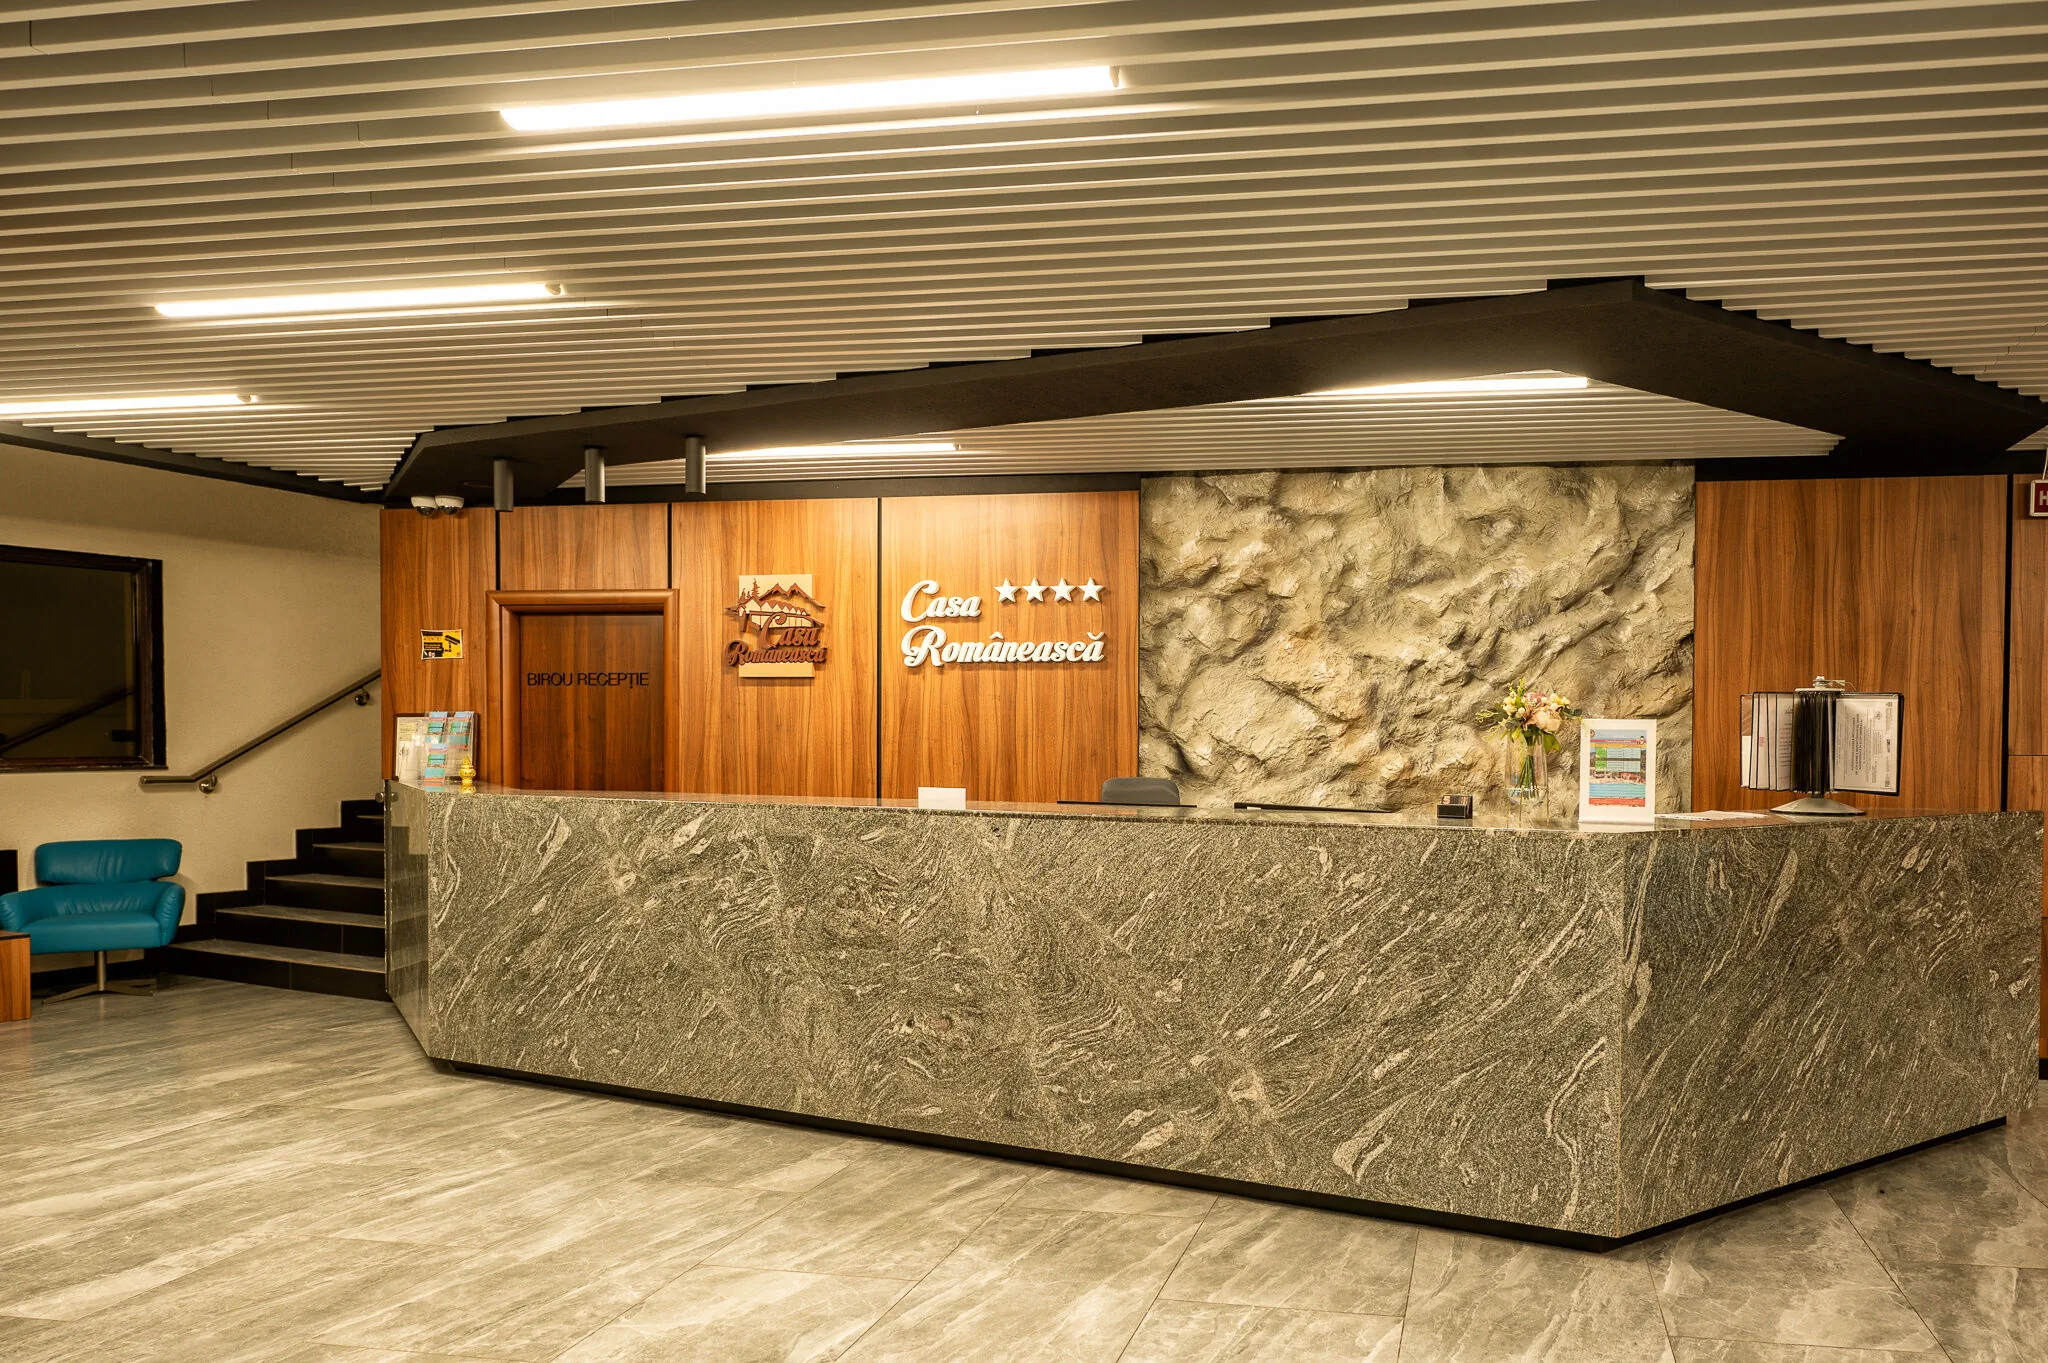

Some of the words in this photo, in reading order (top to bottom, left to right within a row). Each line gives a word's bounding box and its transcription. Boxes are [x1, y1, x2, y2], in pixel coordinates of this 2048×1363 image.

[901, 580, 982, 622] Casa
[760, 612, 820, 650] Casa
[901, 625, 1105, 667] Românească
[527, 672, 573, 686] BIROU
